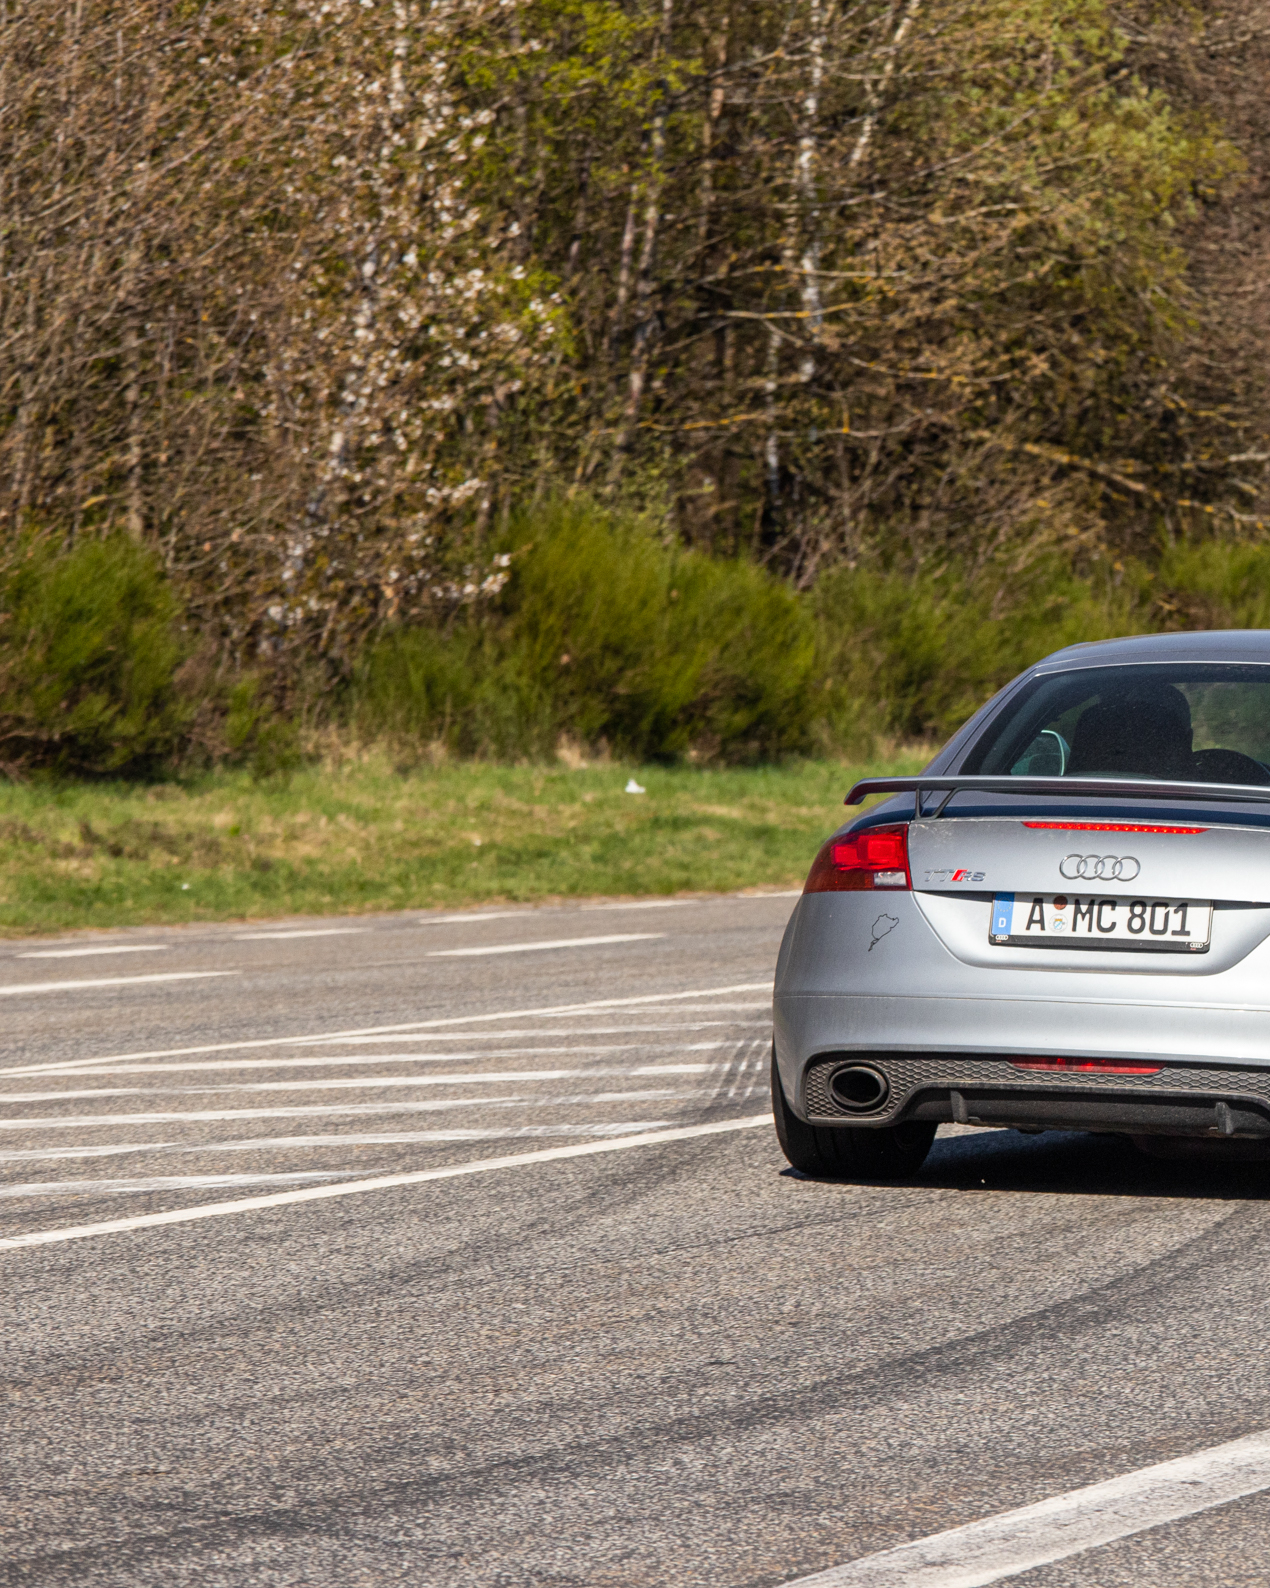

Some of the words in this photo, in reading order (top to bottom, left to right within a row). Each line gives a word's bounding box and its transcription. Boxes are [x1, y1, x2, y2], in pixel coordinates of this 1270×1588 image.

[998, 916, 1006, 928] D
[1025, 897, 1046, 931] A
[1072, 898, 1117, 934] MC
[1127, 900, 1191, 936] 801
